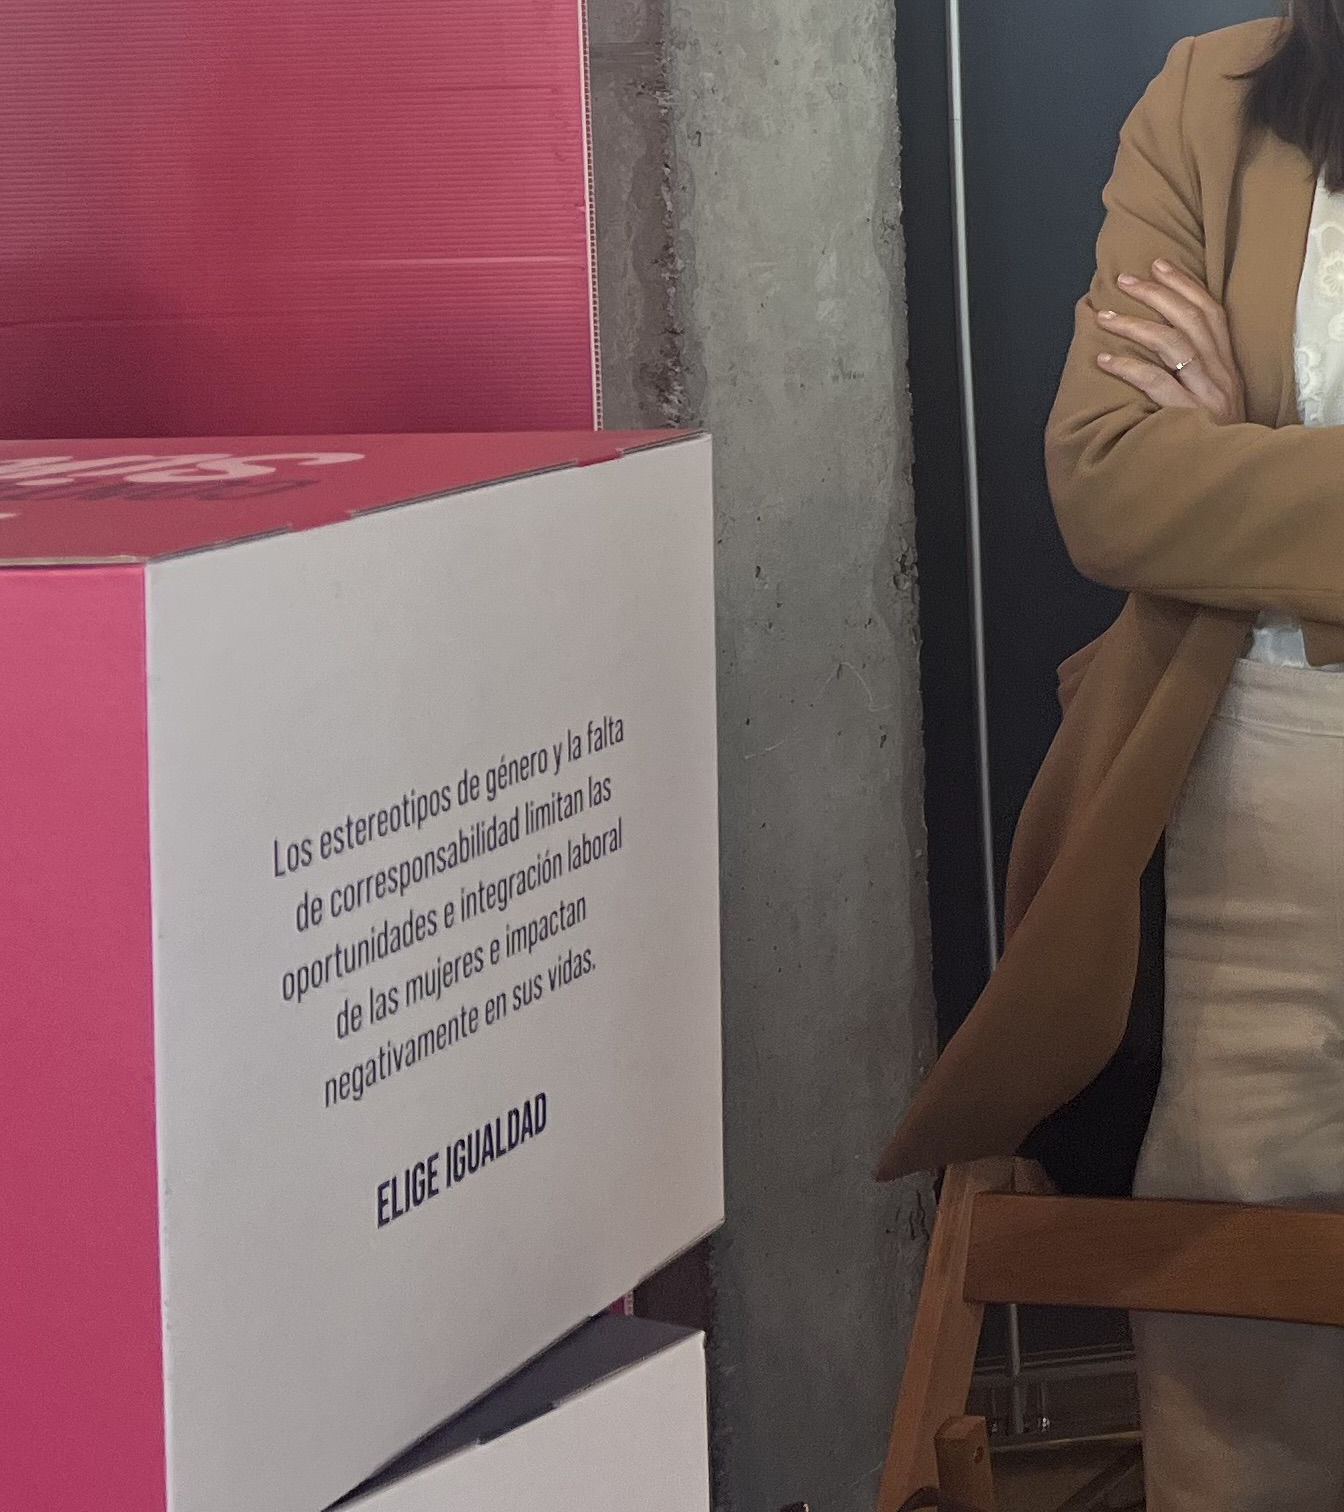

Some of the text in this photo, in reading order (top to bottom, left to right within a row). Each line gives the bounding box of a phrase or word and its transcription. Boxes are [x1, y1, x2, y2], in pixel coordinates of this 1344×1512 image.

[274, 716, 624, 878] Los estereotipos de género y la falta
[296, 776, 612, 932] de corresponsabilidad limitan las
[282, 818, 623, 1003] oportunidades e integración laboral
[337, 896, 587, 1039] de las mujeres e impactan
[324, 947, 596, 1108] negativamente en sus vidas.
[376, 1092, 548, 1230] ELIGE IGUALDAD
